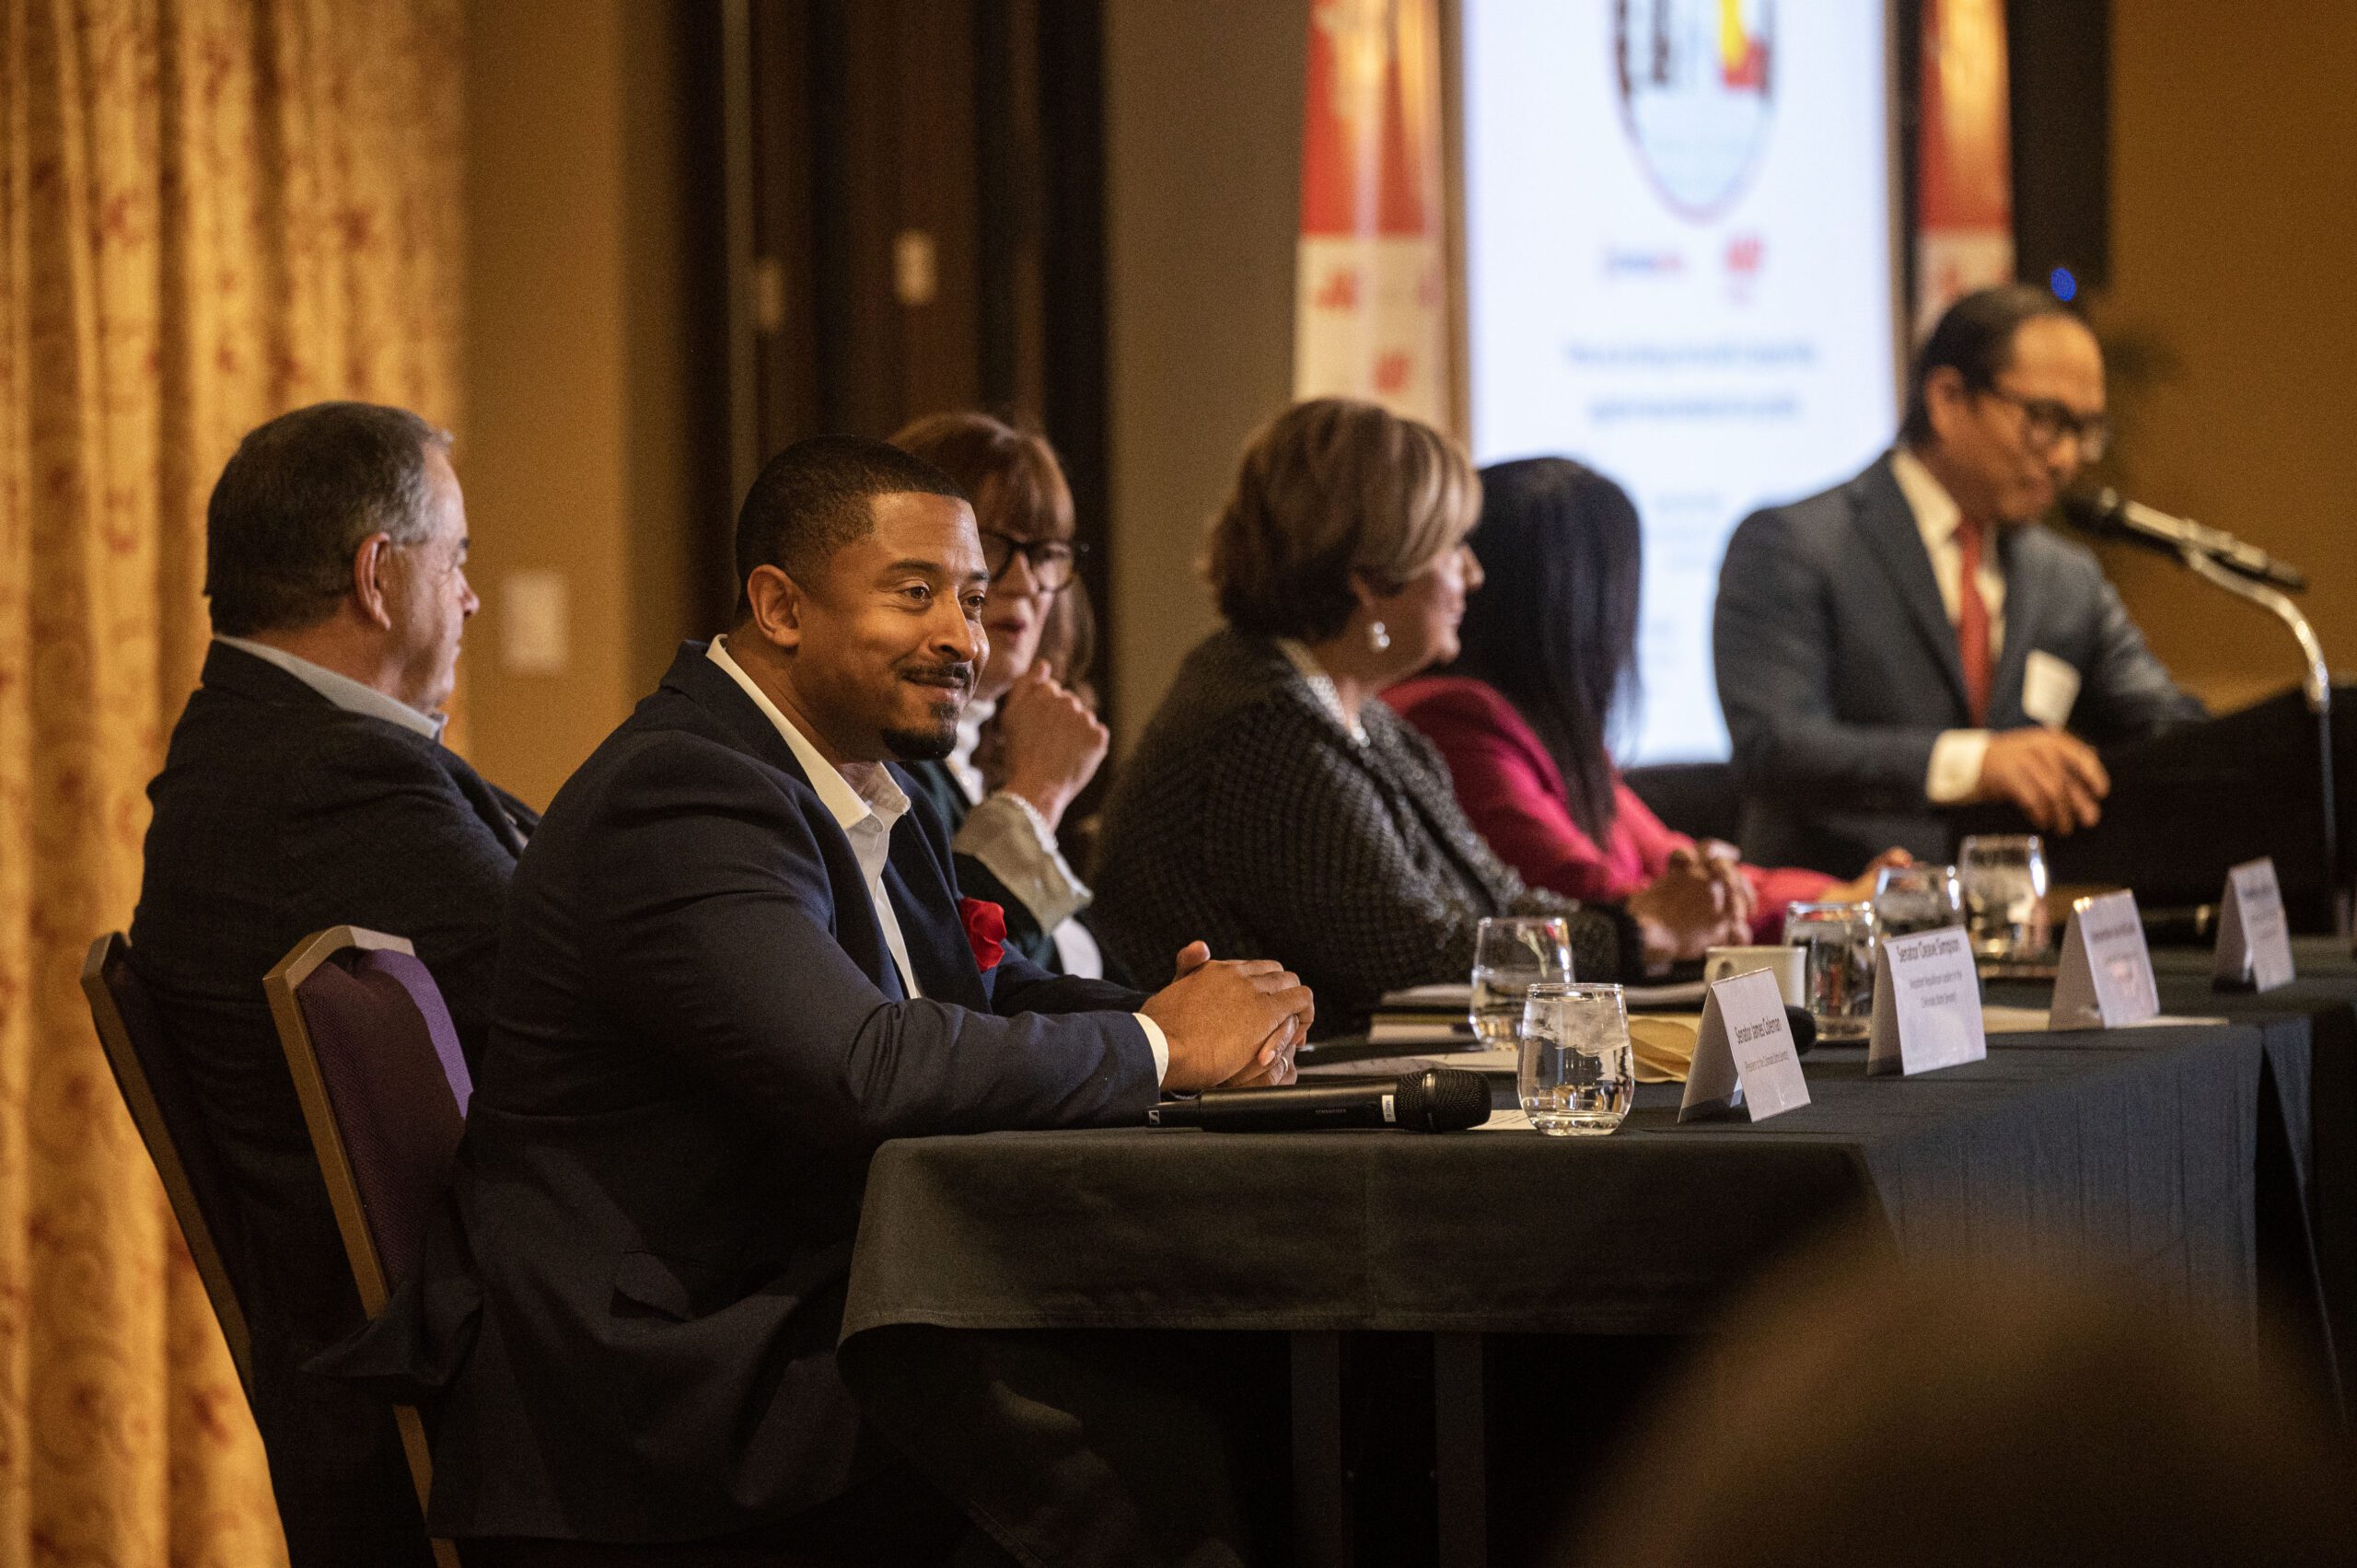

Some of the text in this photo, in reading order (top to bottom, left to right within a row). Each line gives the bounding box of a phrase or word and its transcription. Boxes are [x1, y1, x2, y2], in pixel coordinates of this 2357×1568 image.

[1734, 1016, 1782, 1045] Senator James Coleman
